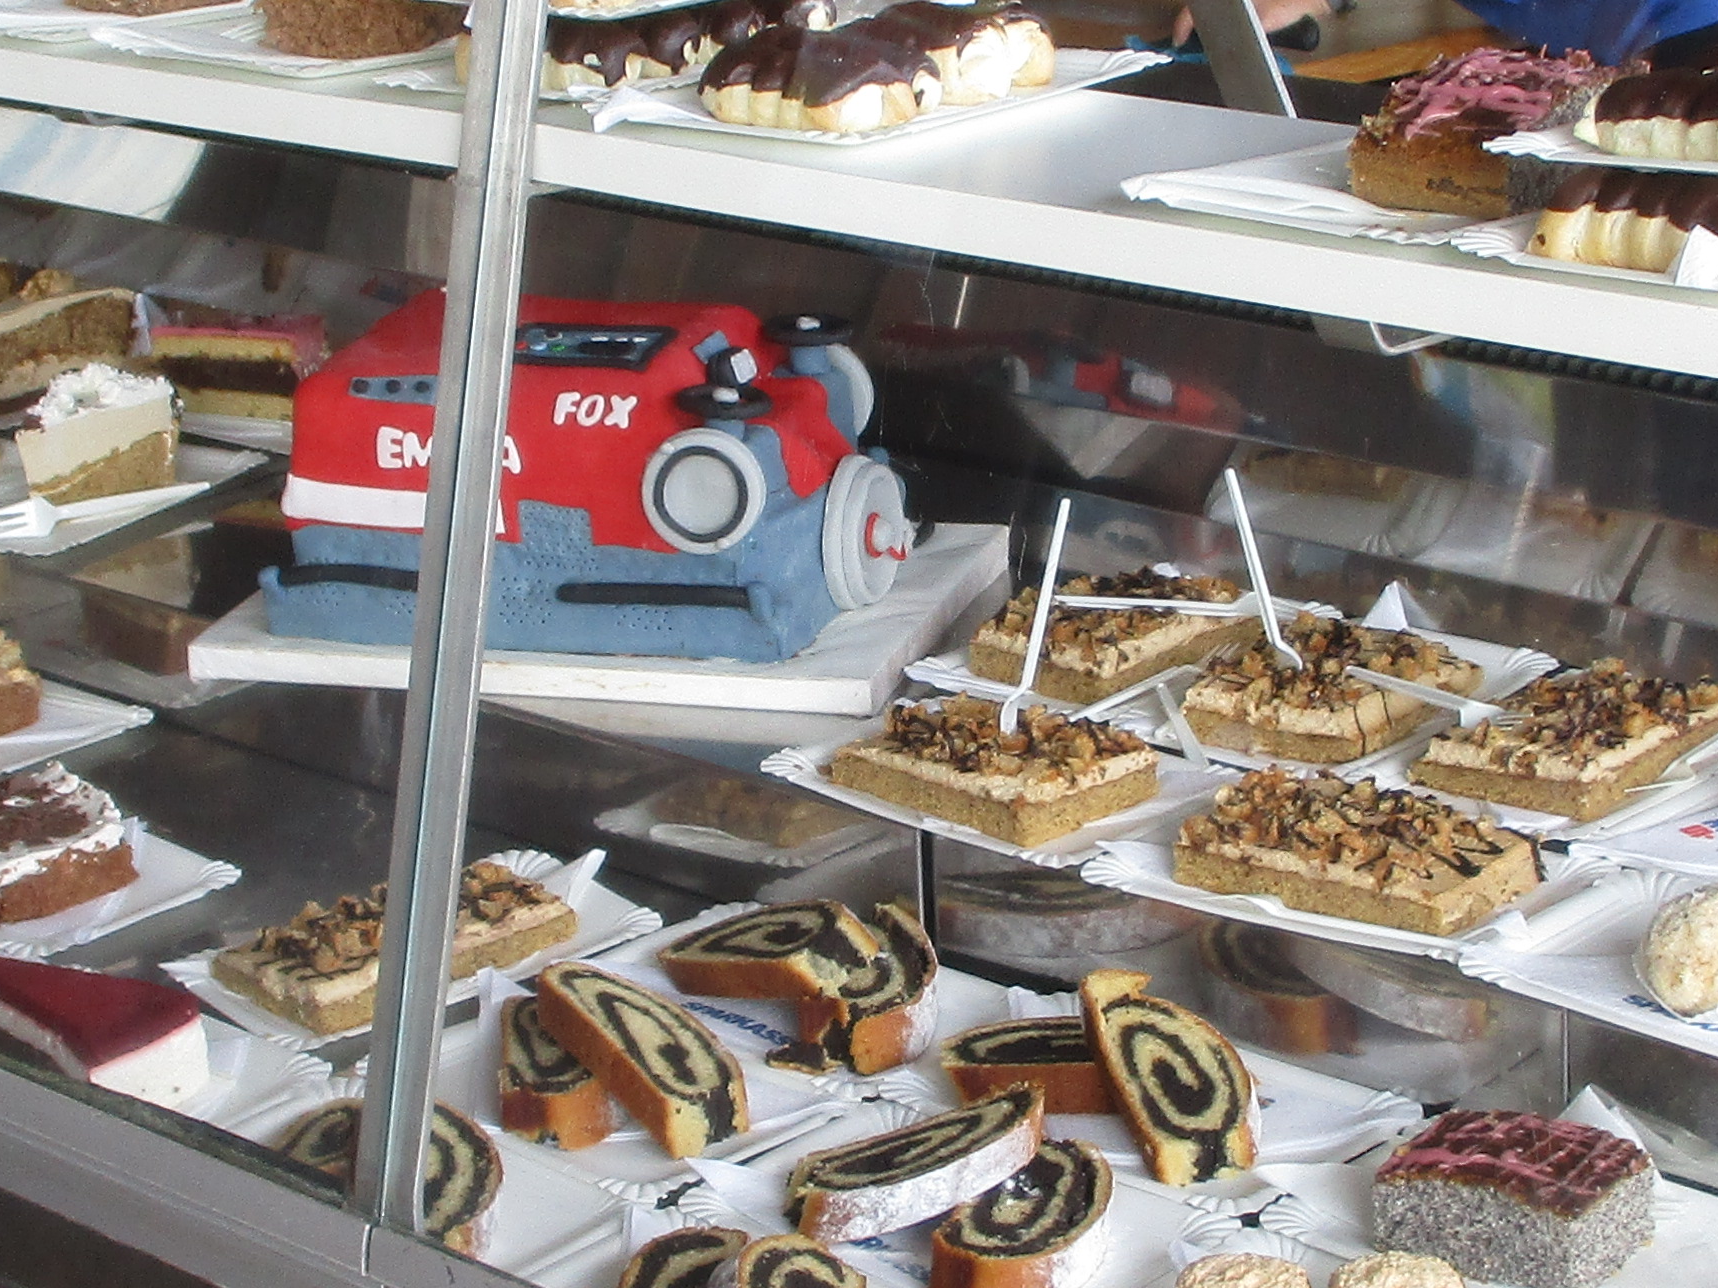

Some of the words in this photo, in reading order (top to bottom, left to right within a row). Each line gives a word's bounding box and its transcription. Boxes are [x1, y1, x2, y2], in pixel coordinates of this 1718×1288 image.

[553, 391, 638, 429] FOX
[376, 425, 522, 475] EMA
[681, 1001, 793, 1046] SPARKASS
